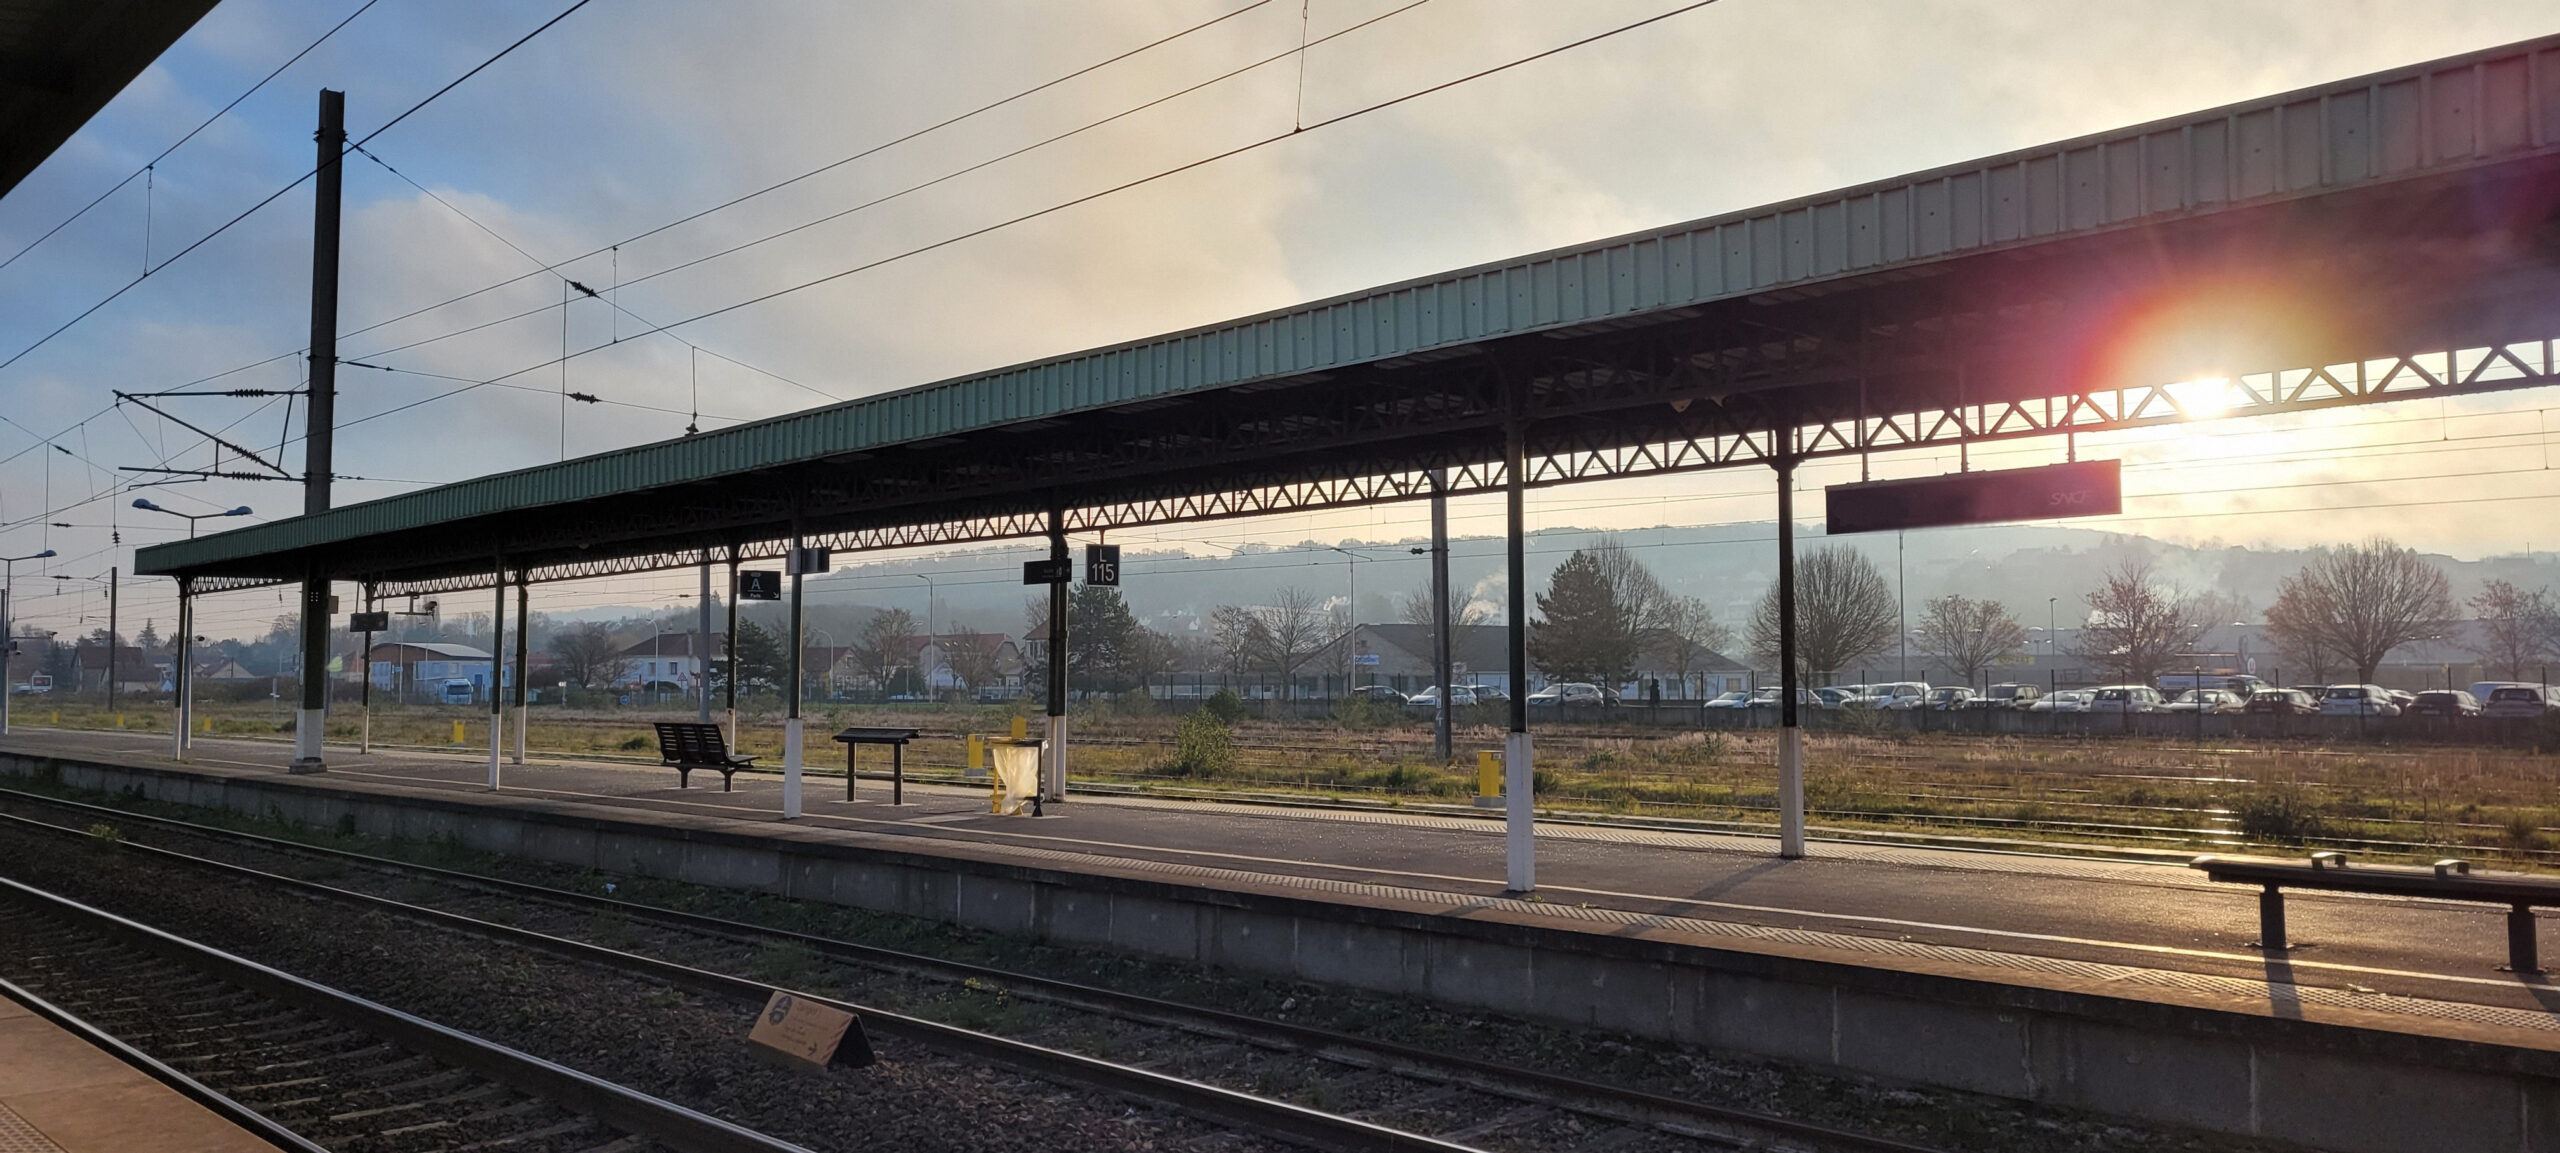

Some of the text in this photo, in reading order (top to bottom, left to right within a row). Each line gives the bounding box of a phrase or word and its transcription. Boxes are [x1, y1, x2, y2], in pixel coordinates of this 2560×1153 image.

[2049, 490, 2090, 505] SNCF
[1099, 548, 1107, 563] L
[1091, 563, 1114, 582] 115
[751, 577, 761, 590] A
